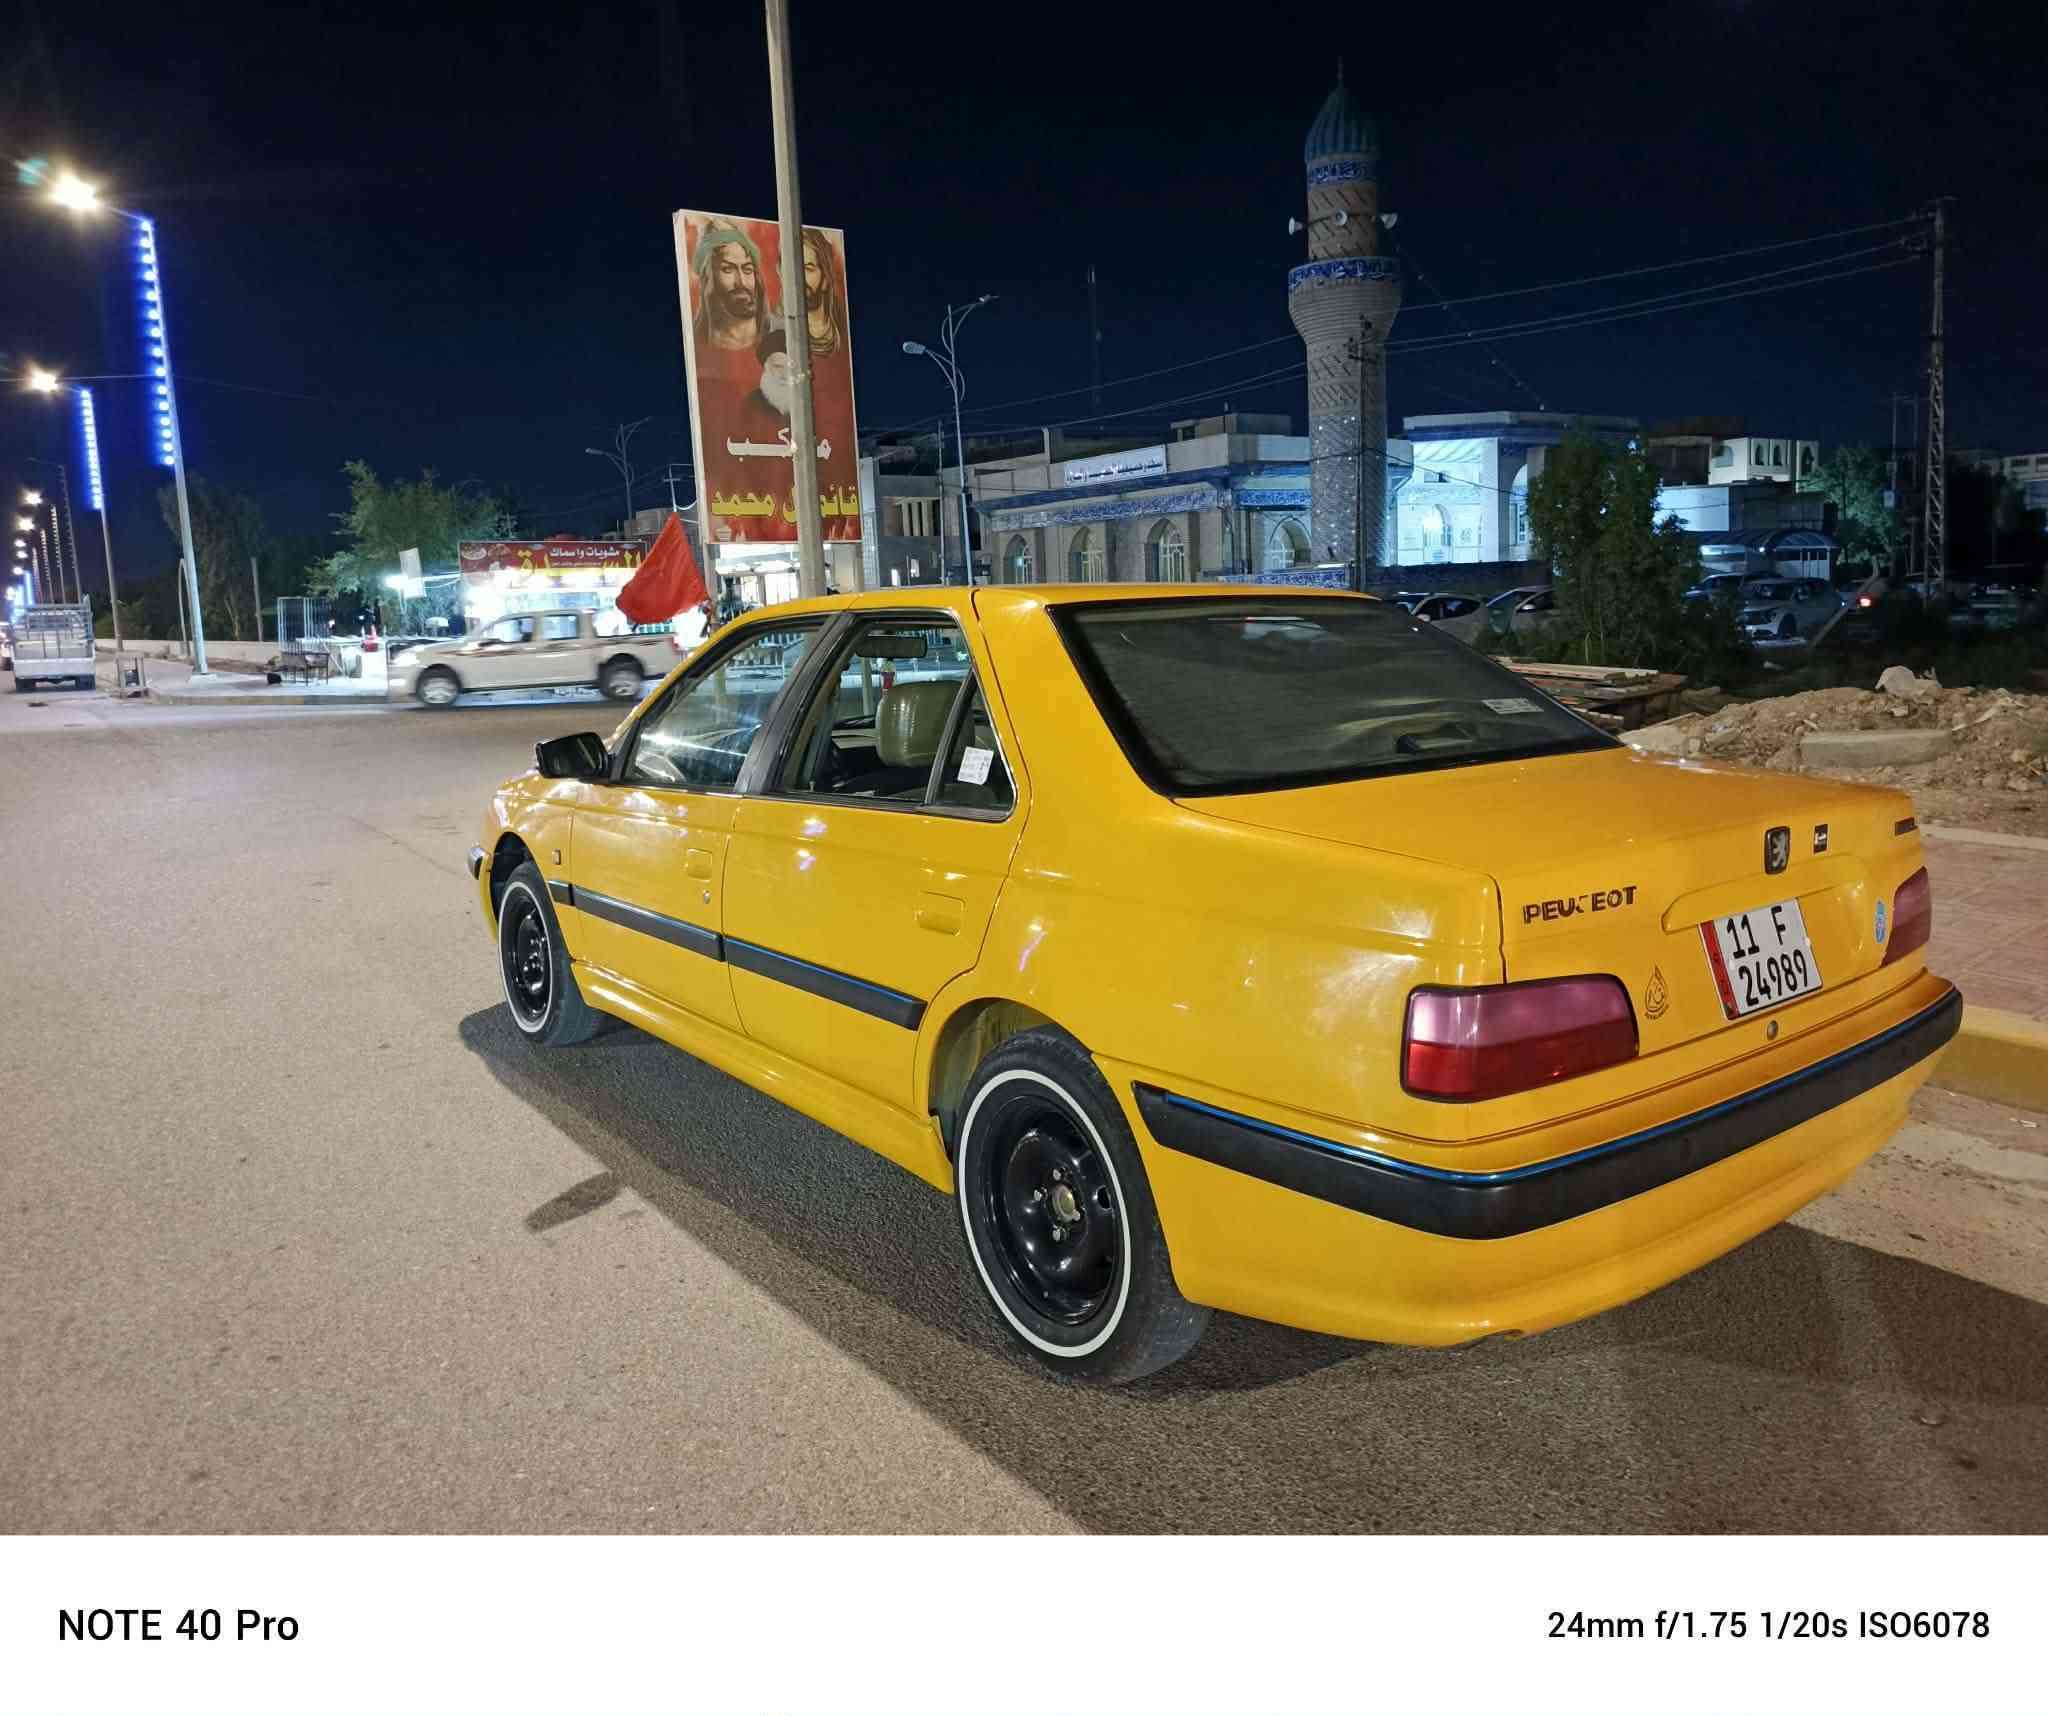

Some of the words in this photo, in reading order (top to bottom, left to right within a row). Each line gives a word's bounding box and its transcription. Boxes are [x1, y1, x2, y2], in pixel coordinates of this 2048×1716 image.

[727, 427, 832, 462] مكب
[711, 490, 776, 517] محمد
[1726, 914, 1760, 959] 11
[1770, 905, 1786, 946] F
[1738, 949, 1808, 1007] 24989
